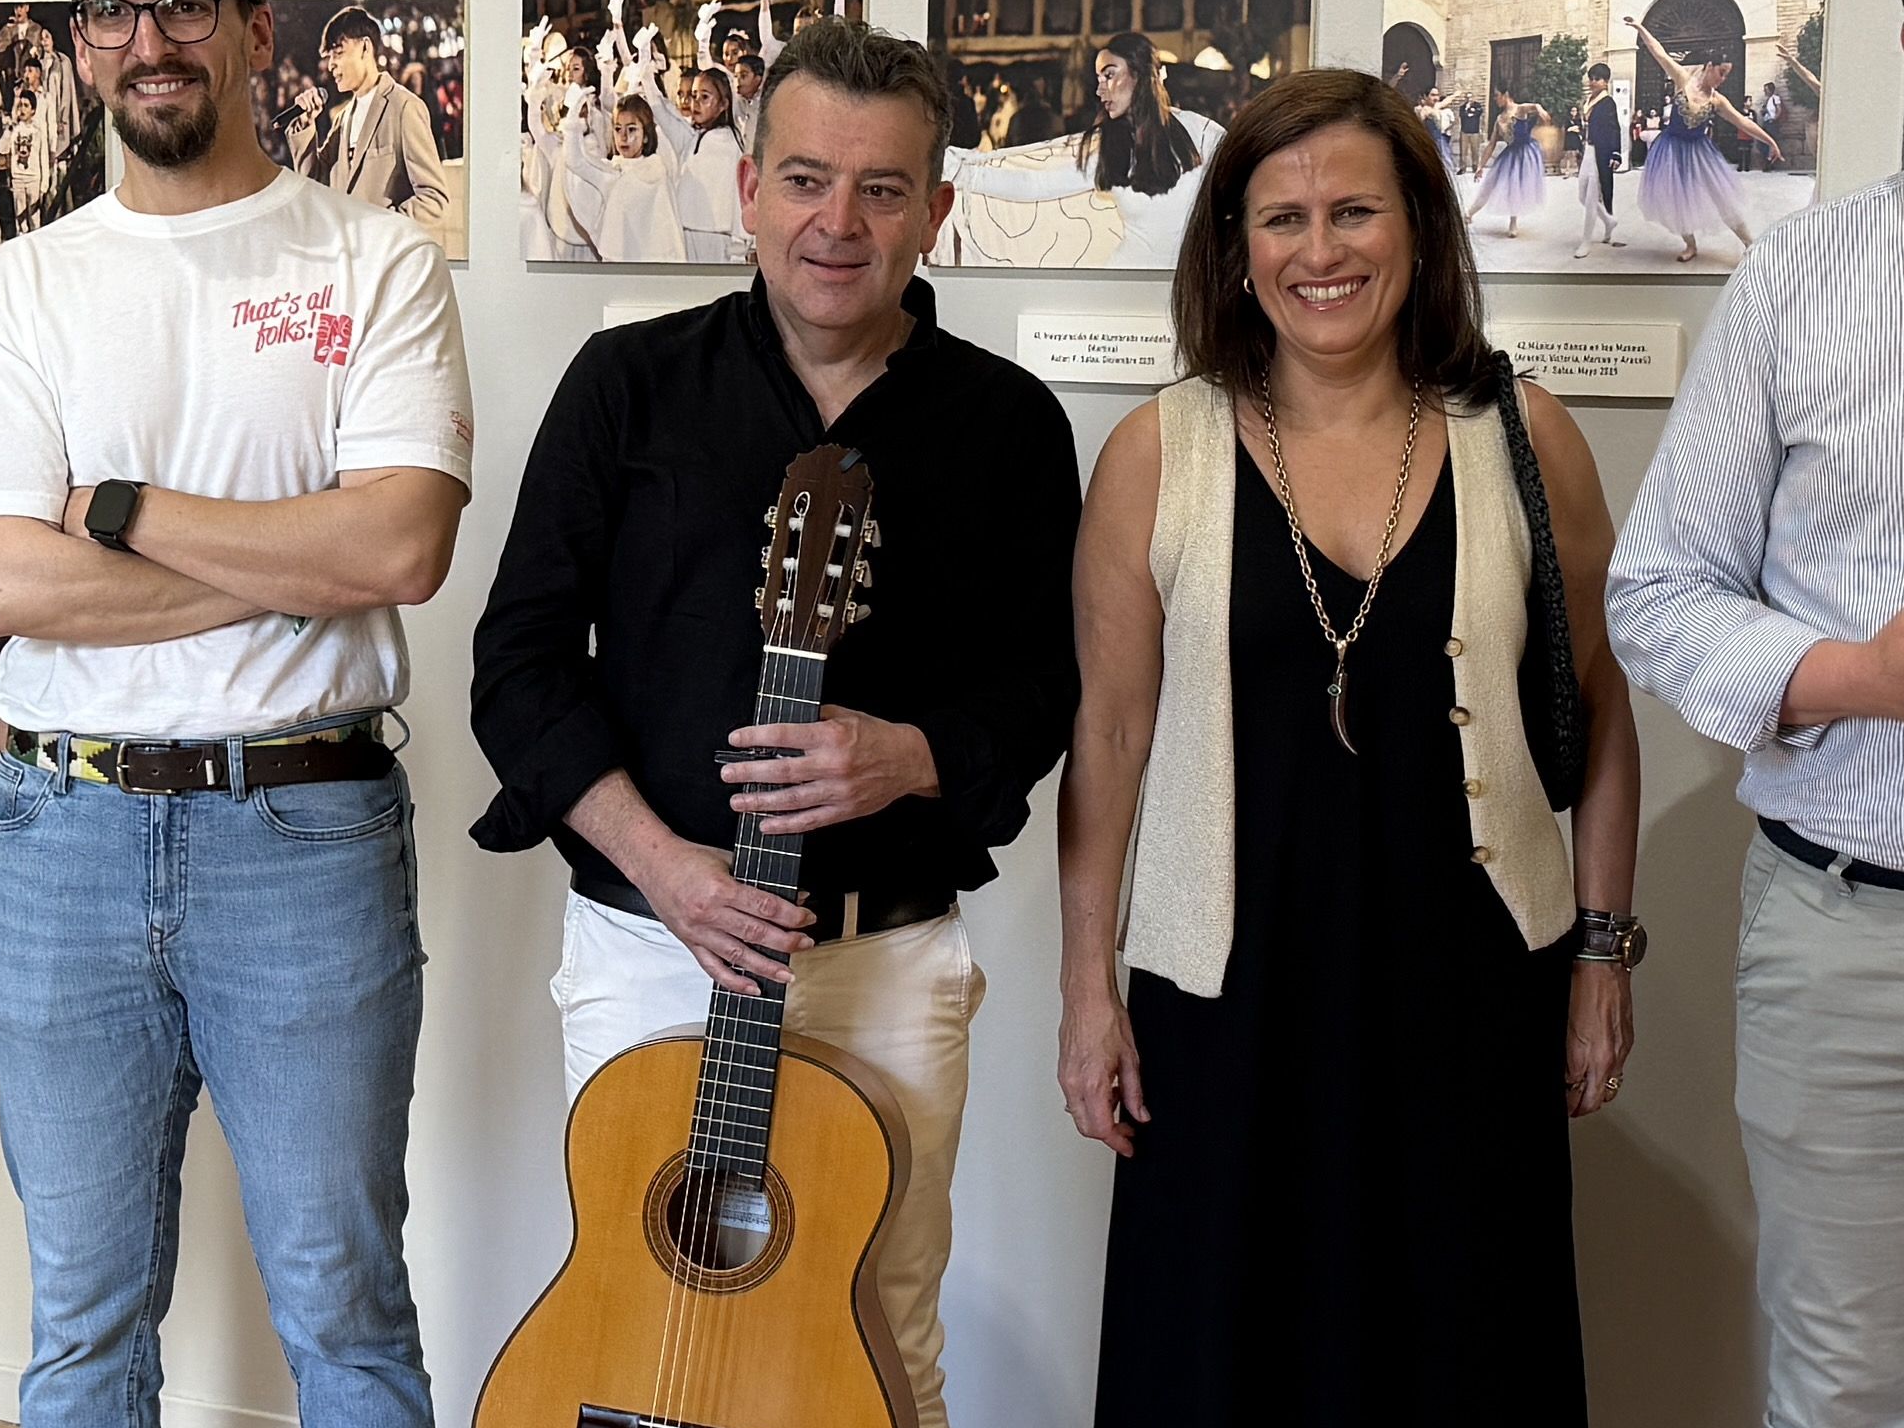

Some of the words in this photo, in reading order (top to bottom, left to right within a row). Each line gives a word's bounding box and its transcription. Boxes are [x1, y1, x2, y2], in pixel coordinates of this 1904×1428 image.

[232, 292, 302, 328] That's
[307, 284, 334, 310] all
[255, 312, 316, 353] folks!
